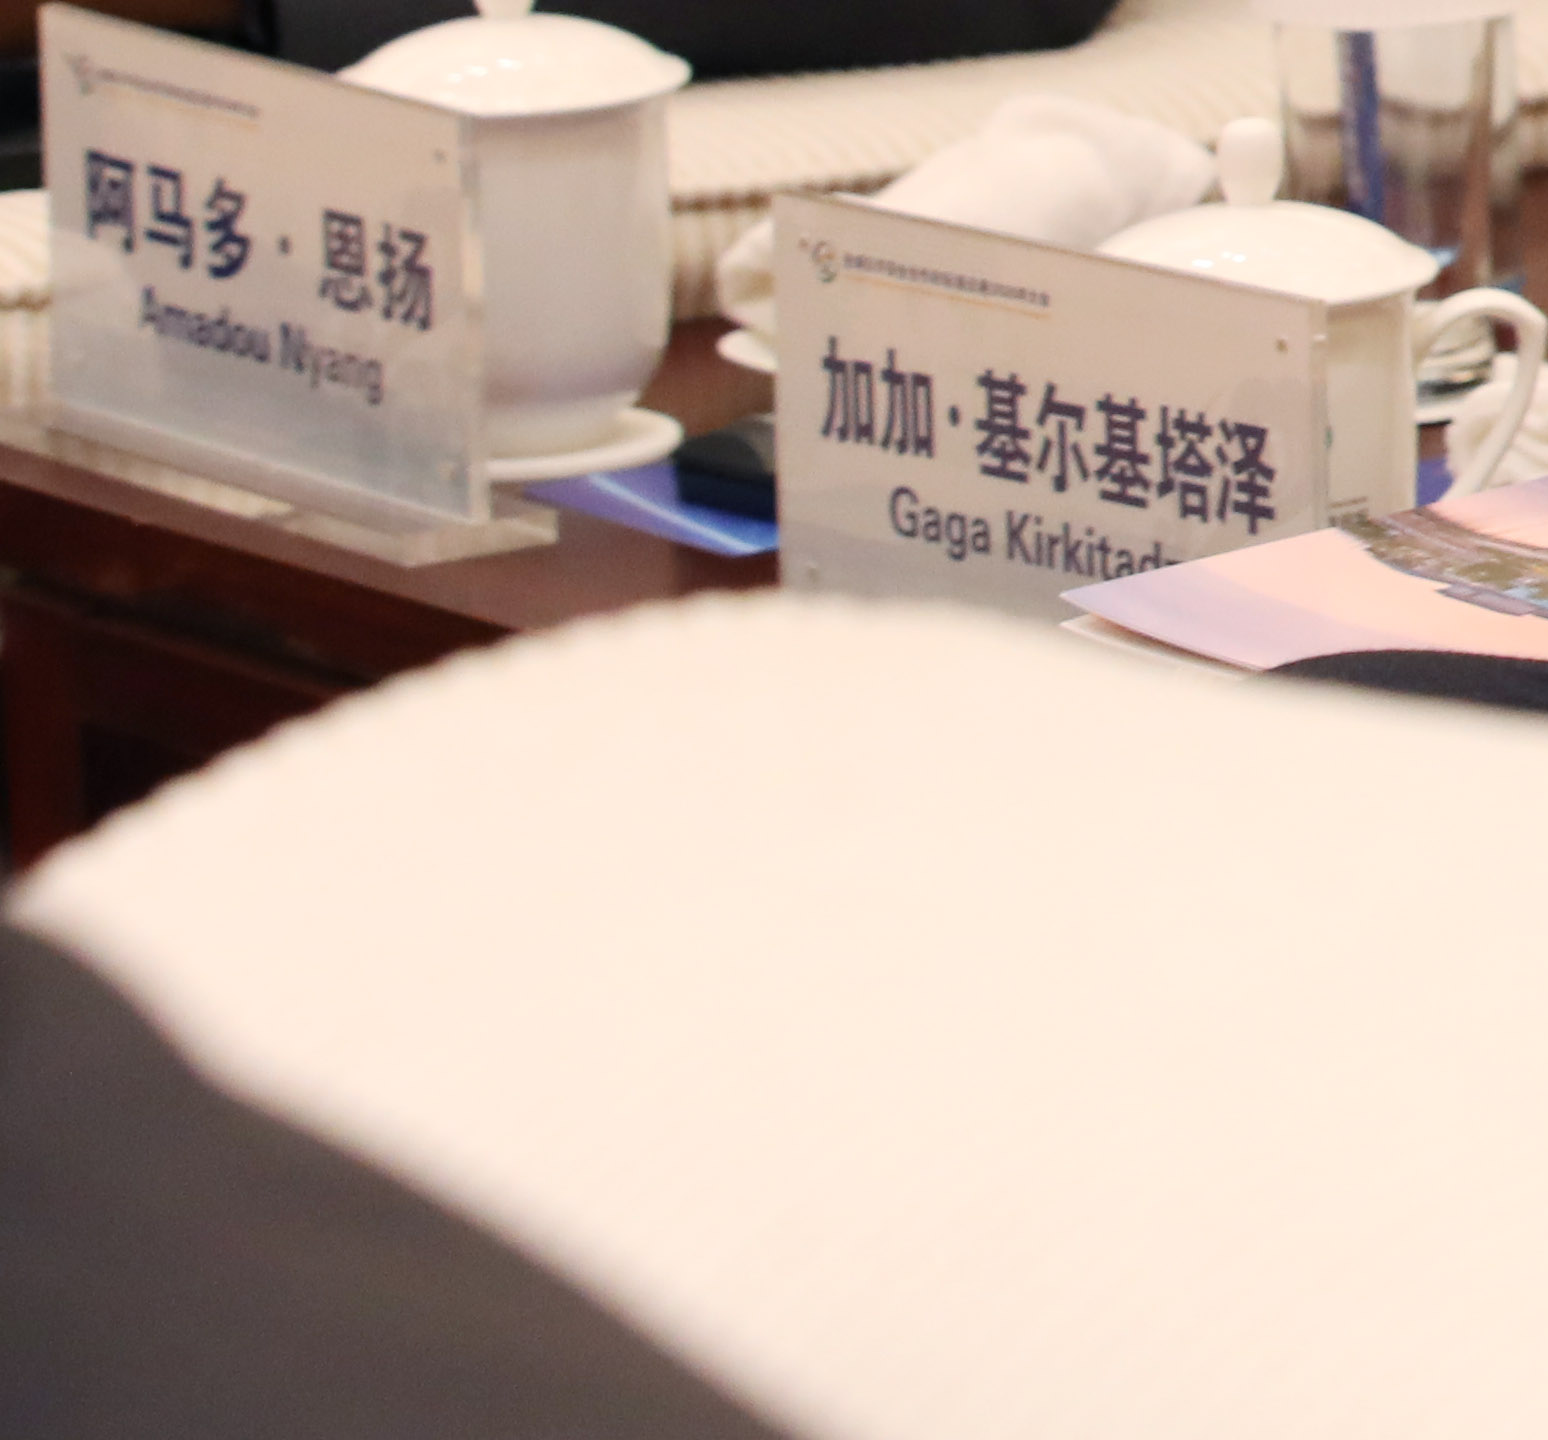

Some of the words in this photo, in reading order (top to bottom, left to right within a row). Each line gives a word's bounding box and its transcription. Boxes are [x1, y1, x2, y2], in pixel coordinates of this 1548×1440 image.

[141, 285, 271, 364] Amadou
[278, 320, 384, 407] Nyang
[819, 334, 1278, 536] 加加·基尔基塔泽
[888, 485, 992, 562] Gaga
[1004, 508, 1186, 582] Kirkitad
